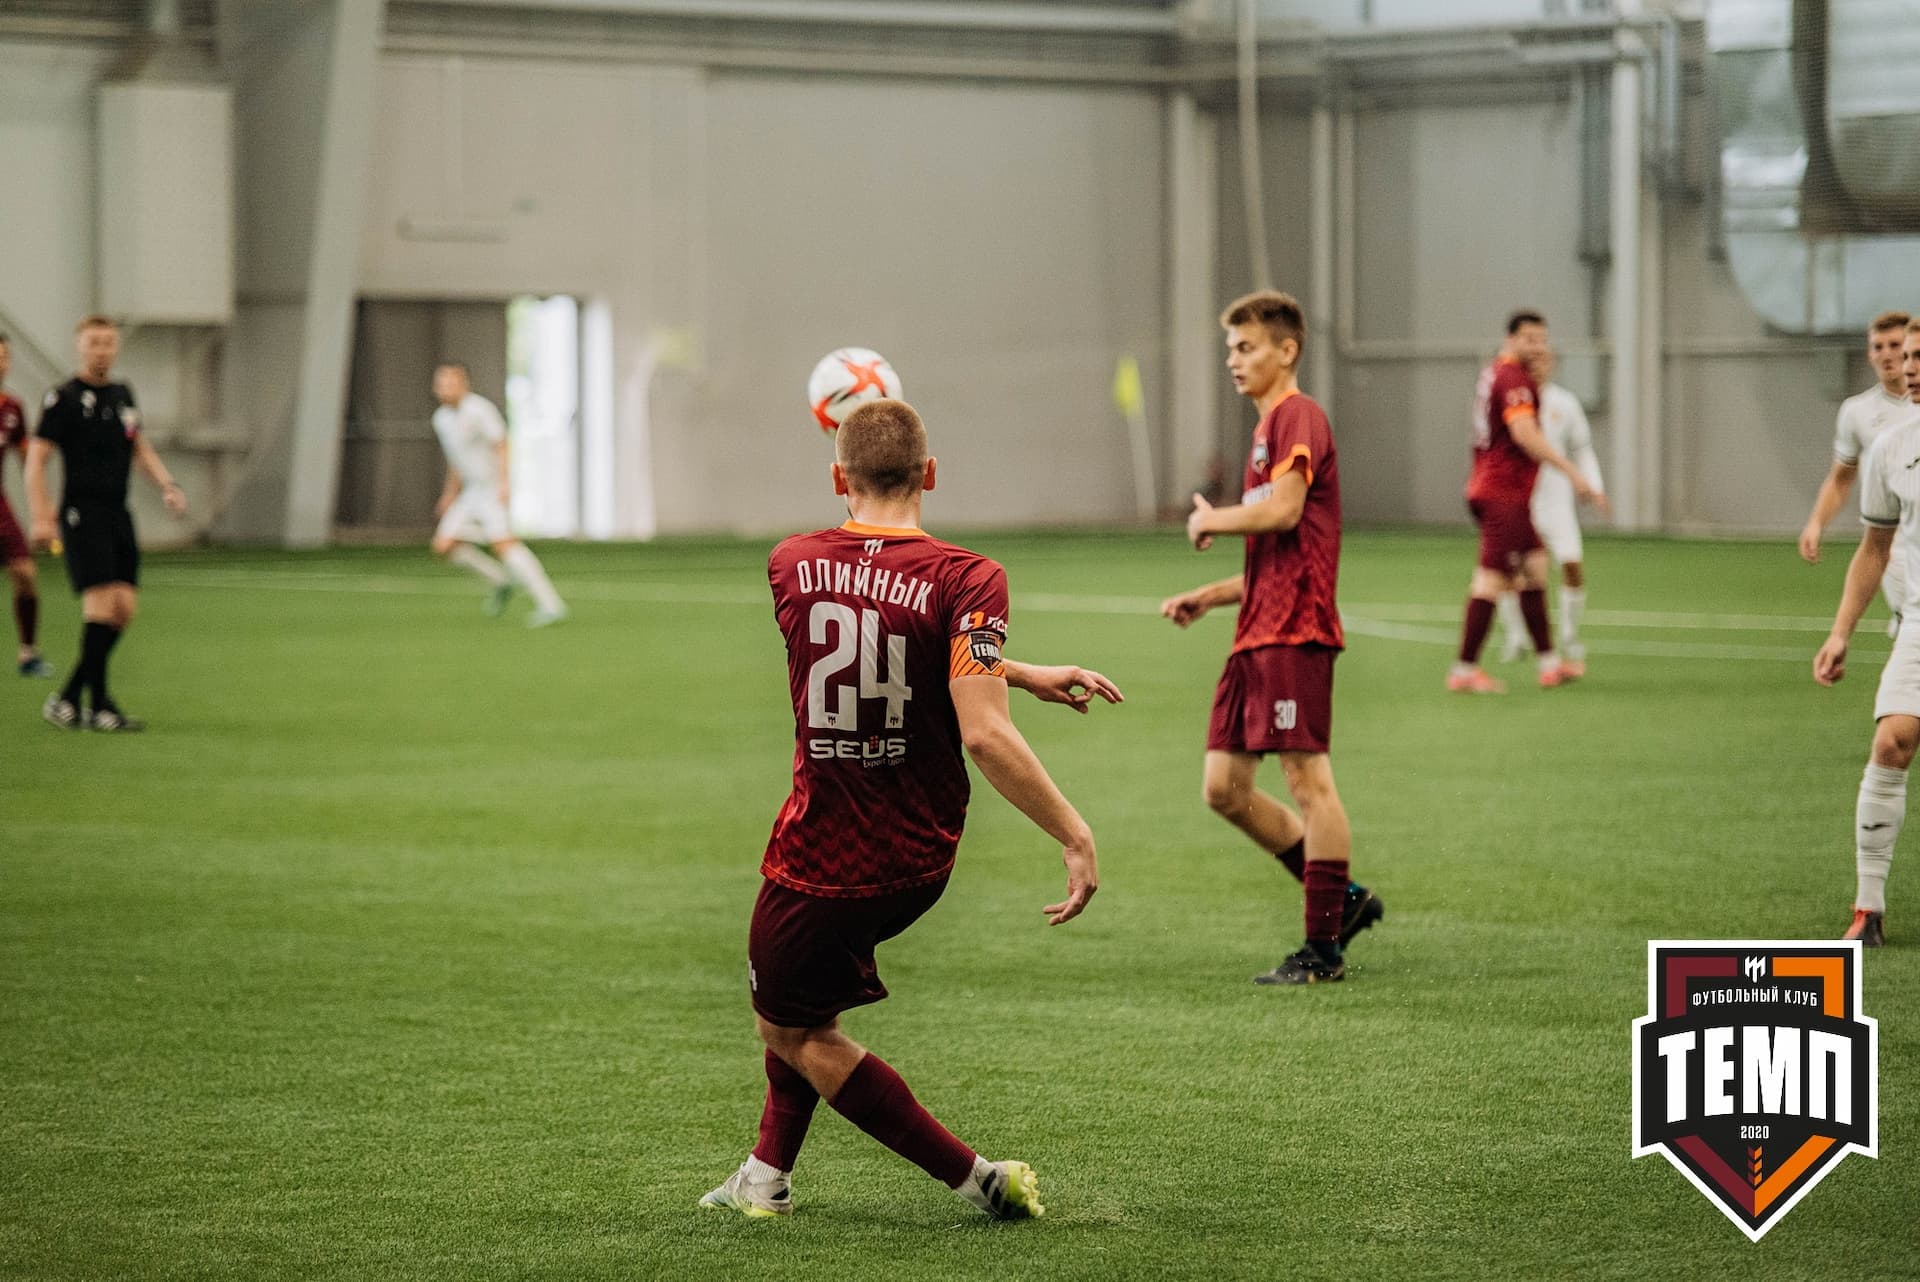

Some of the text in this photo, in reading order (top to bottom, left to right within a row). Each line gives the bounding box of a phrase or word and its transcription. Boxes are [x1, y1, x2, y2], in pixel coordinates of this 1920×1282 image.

[797, 557, 934, 614] ОЛИЙНЫК
[808, 601, 912, 732] 24
[1274, 699, 1297, 730] 30
[809, 737, 906, 760] SEUS
